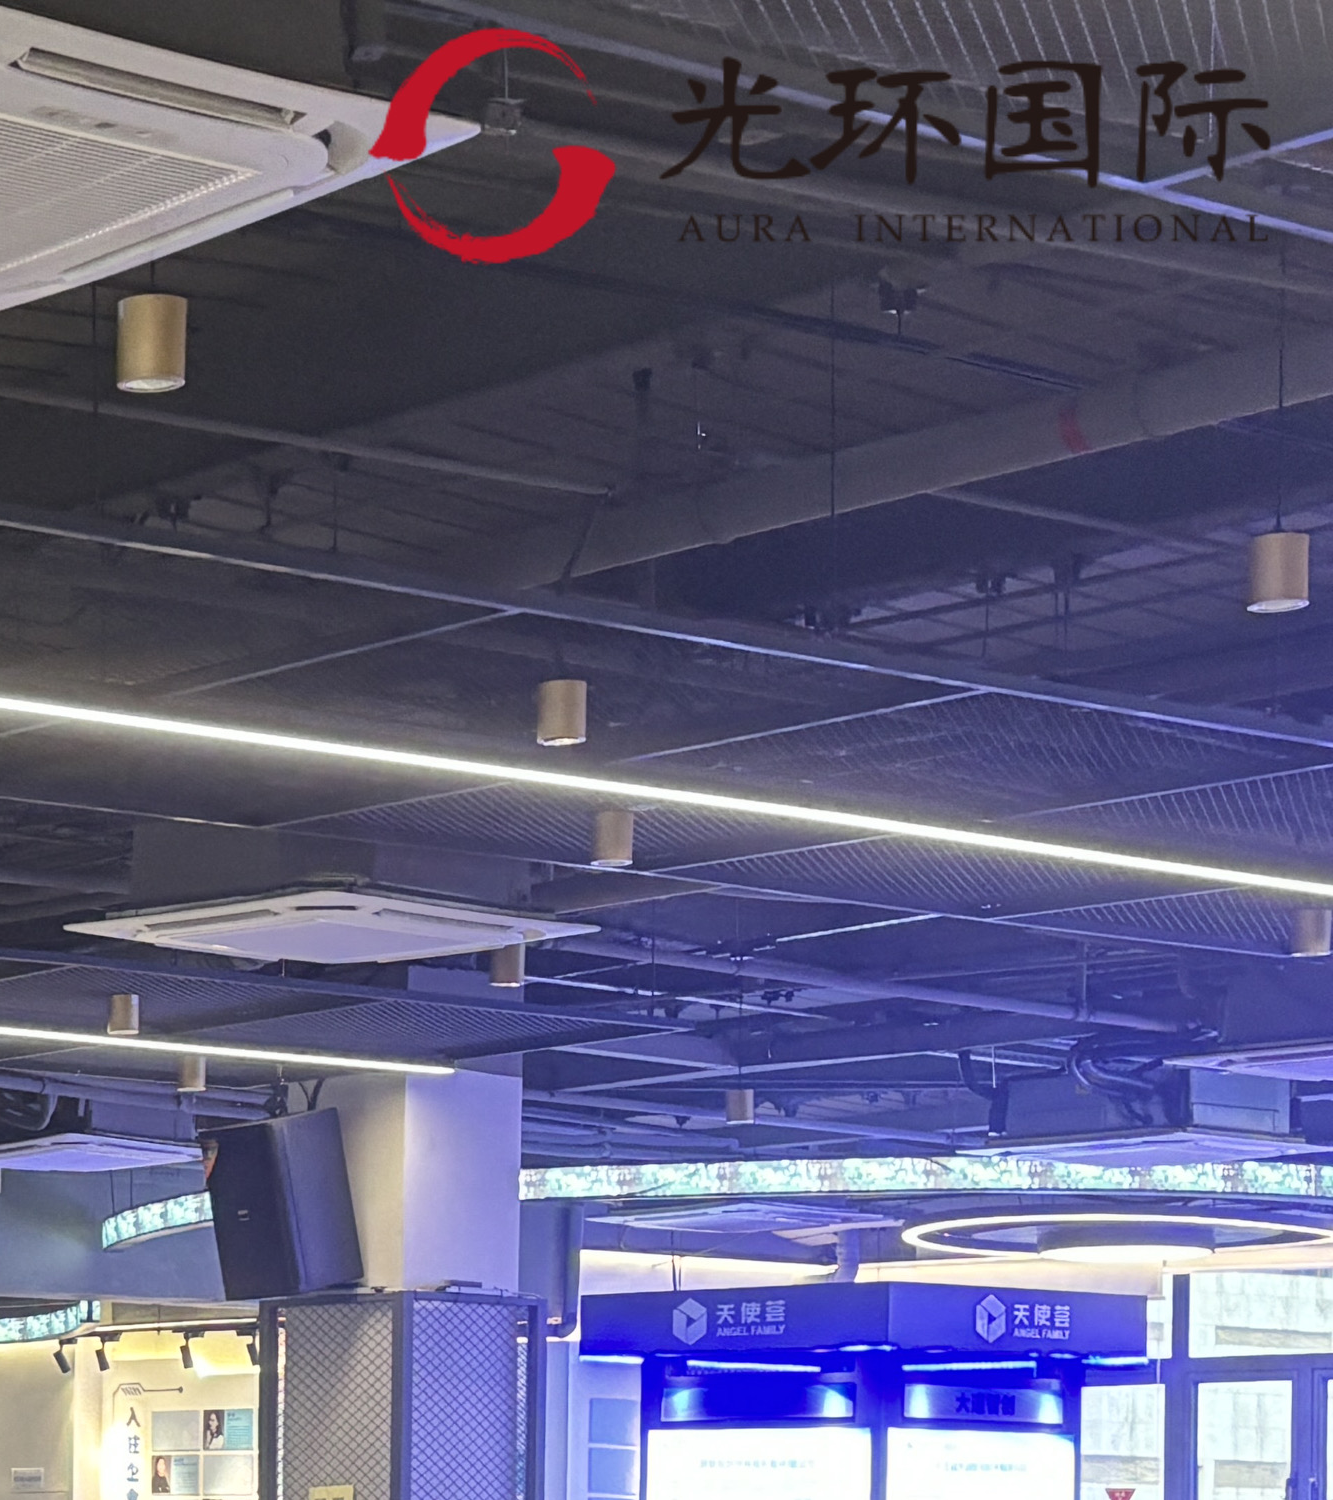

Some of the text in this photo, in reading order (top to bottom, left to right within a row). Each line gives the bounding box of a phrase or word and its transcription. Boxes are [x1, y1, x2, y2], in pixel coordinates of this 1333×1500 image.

[716, 1300, 786, 1324] 天使荟
[1013, 1303, 1070, 1327] 天使荟
[716, 1324, 786, 1337] ANGEL FAMILY
